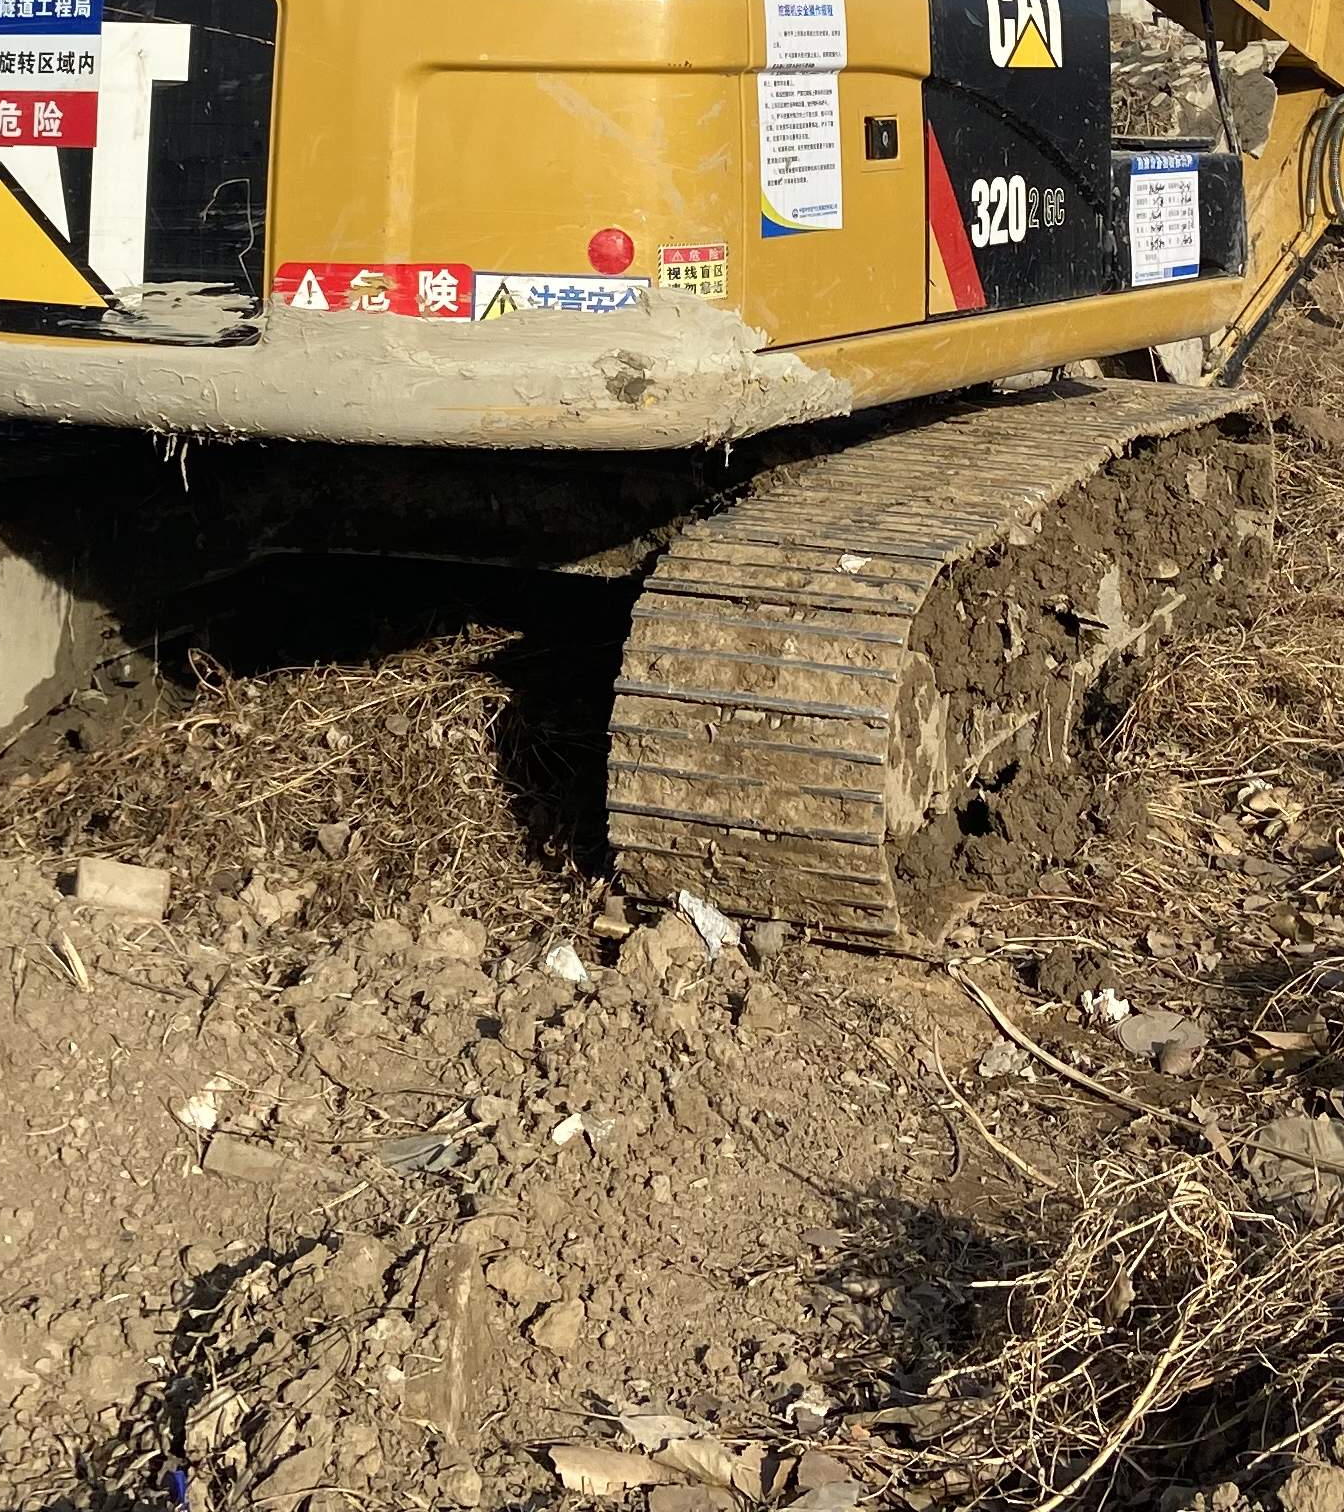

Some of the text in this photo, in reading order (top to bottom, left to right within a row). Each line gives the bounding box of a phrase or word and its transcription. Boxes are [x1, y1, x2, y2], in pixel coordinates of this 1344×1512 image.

[971, 174, 1065, 248] 320 2 GC
[666, 264, 723, 280] 视线盲区
